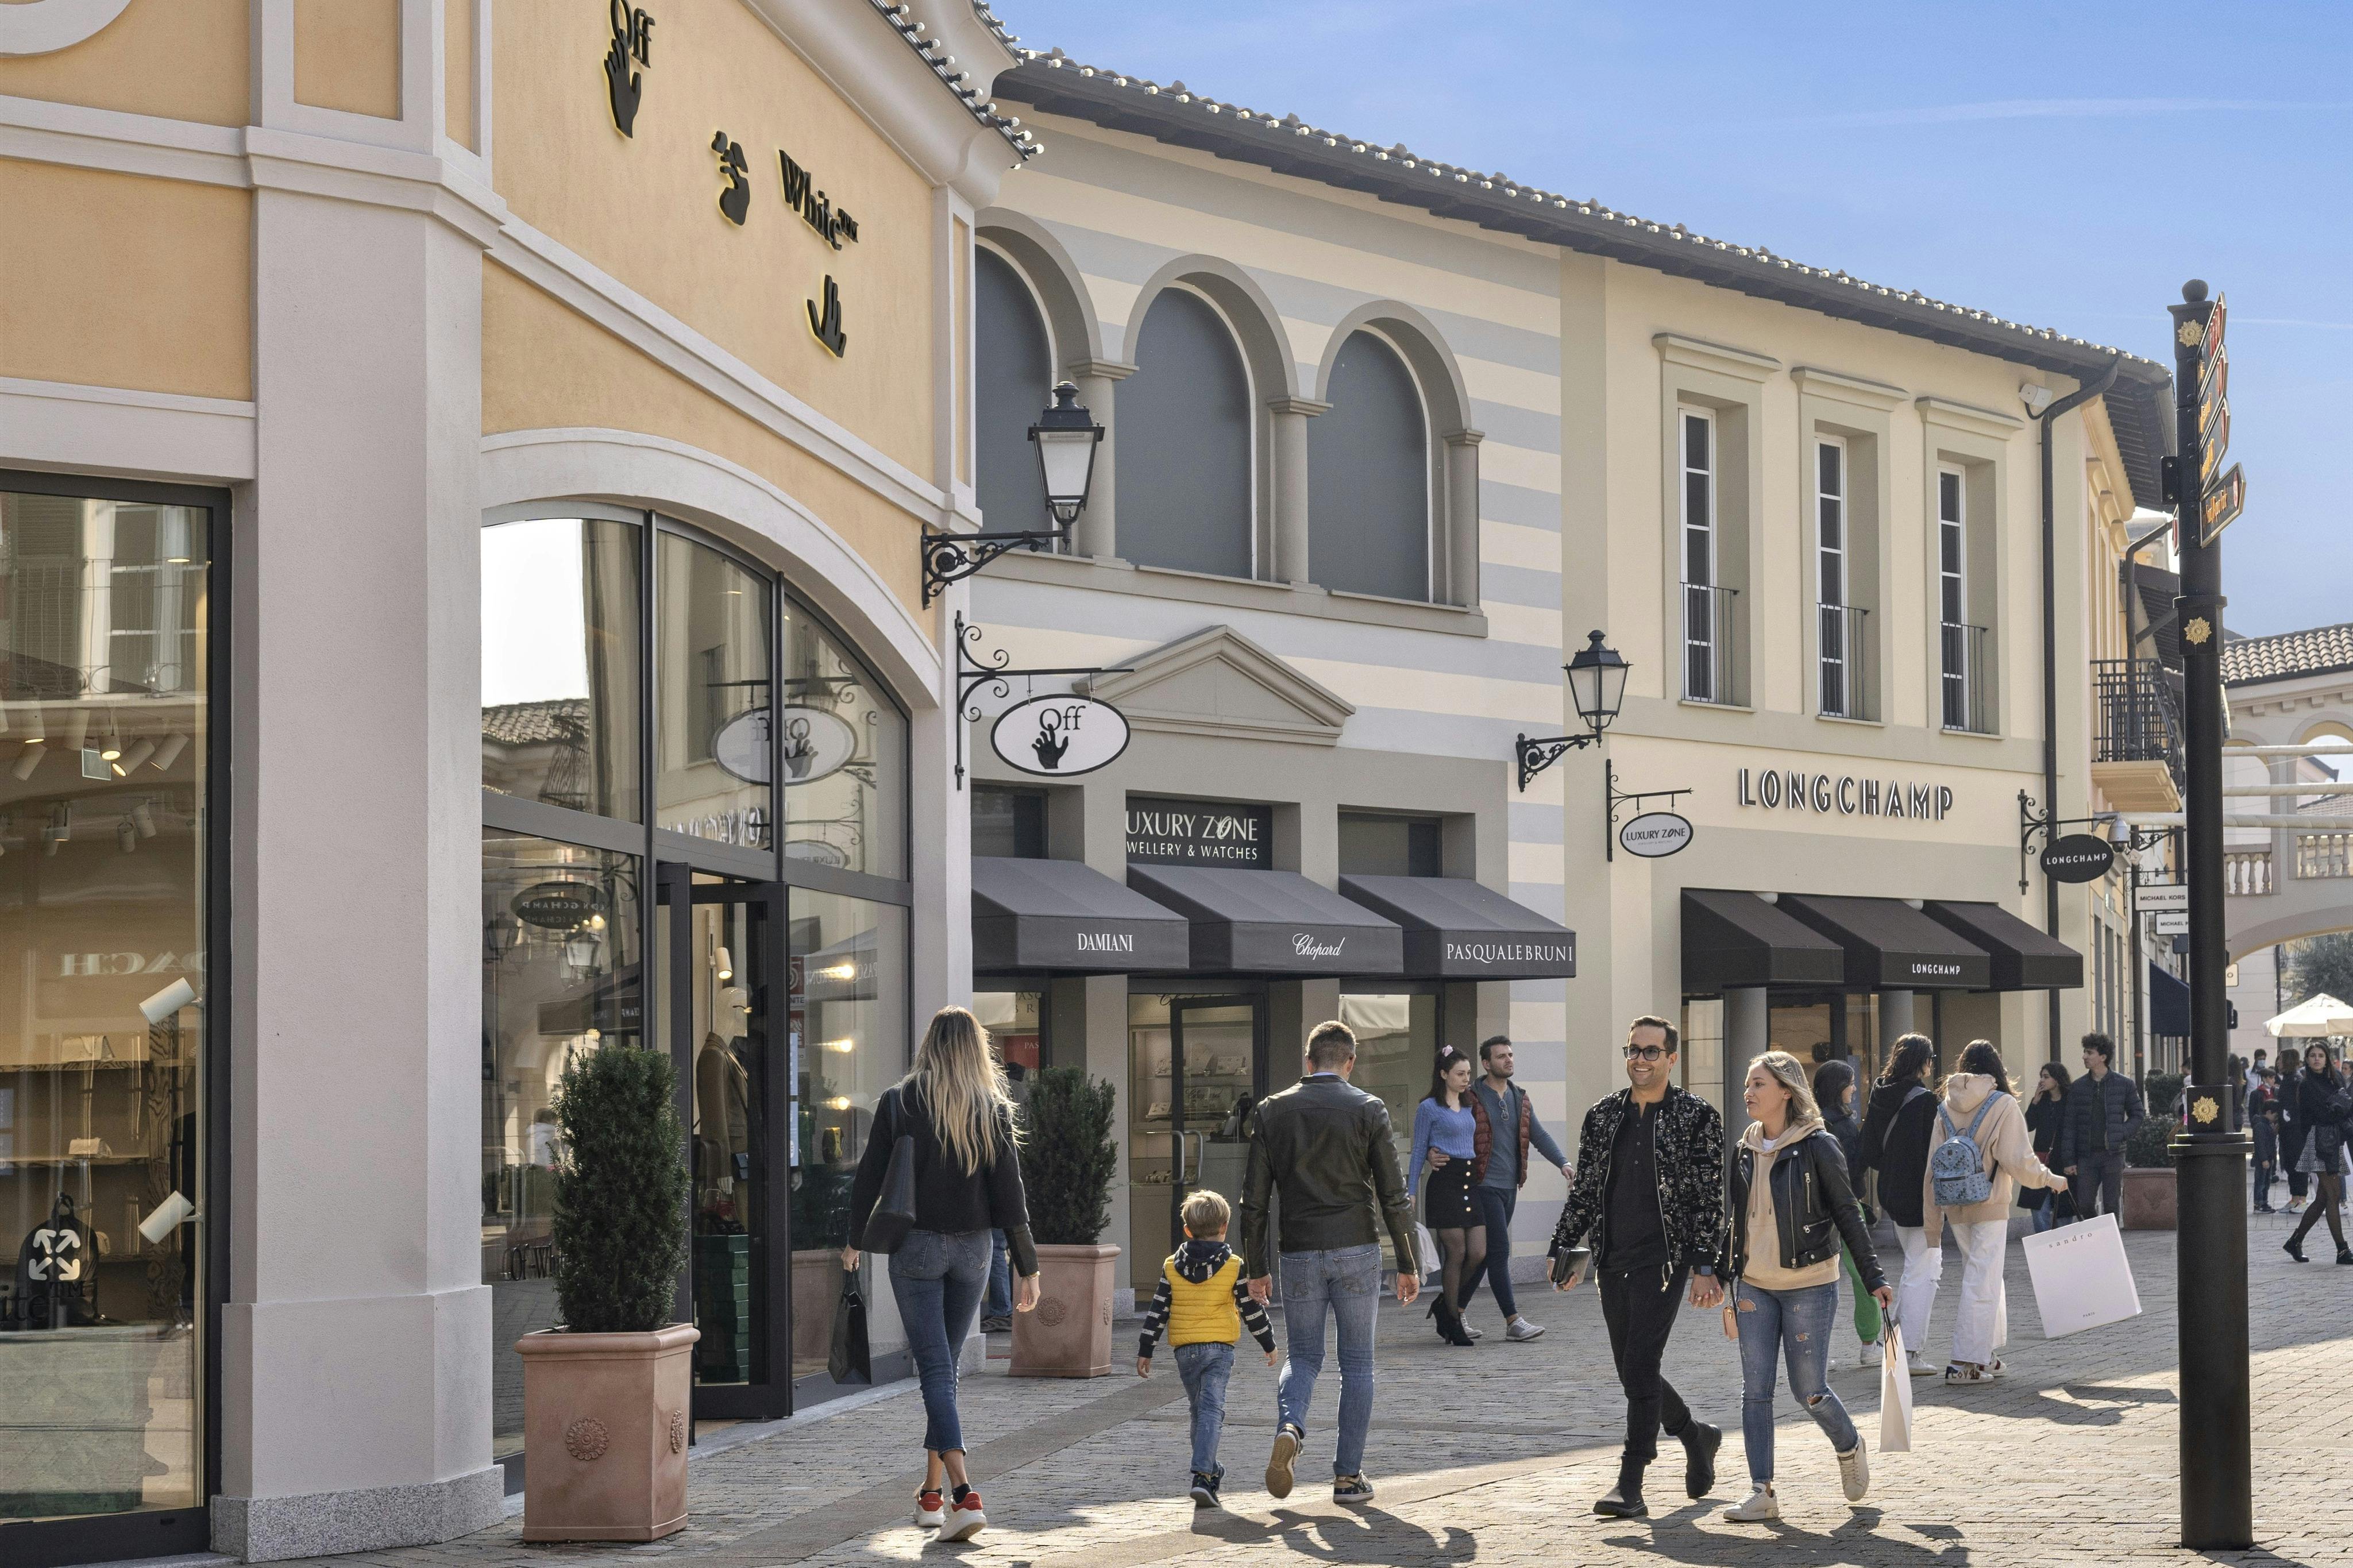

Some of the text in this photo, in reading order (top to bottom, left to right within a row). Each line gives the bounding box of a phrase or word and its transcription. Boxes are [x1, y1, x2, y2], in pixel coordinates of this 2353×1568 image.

[610, 0, 655, 68] Off
[1039, 705, 1086, 731] Off
[1739, 767, 1953, 821] LONGCHAMP
[1202, 816, 1258, 840] ZONE
[1626, 828, 1685, 841] LUXURY ZONE
[1187, 844, 1195, 856] &
[1201, 845, 1257, 860] WATCHES
[2047, 853, 2107, 865] LONGCHAMP
[1077, 933, 1133, 952] DAMIANI
[1293, 933, 1345, 960] Chopard
[1912, 963, 1960, 975] LONGCHAMP
[2049, 1232, 2093, 1249] sandro
